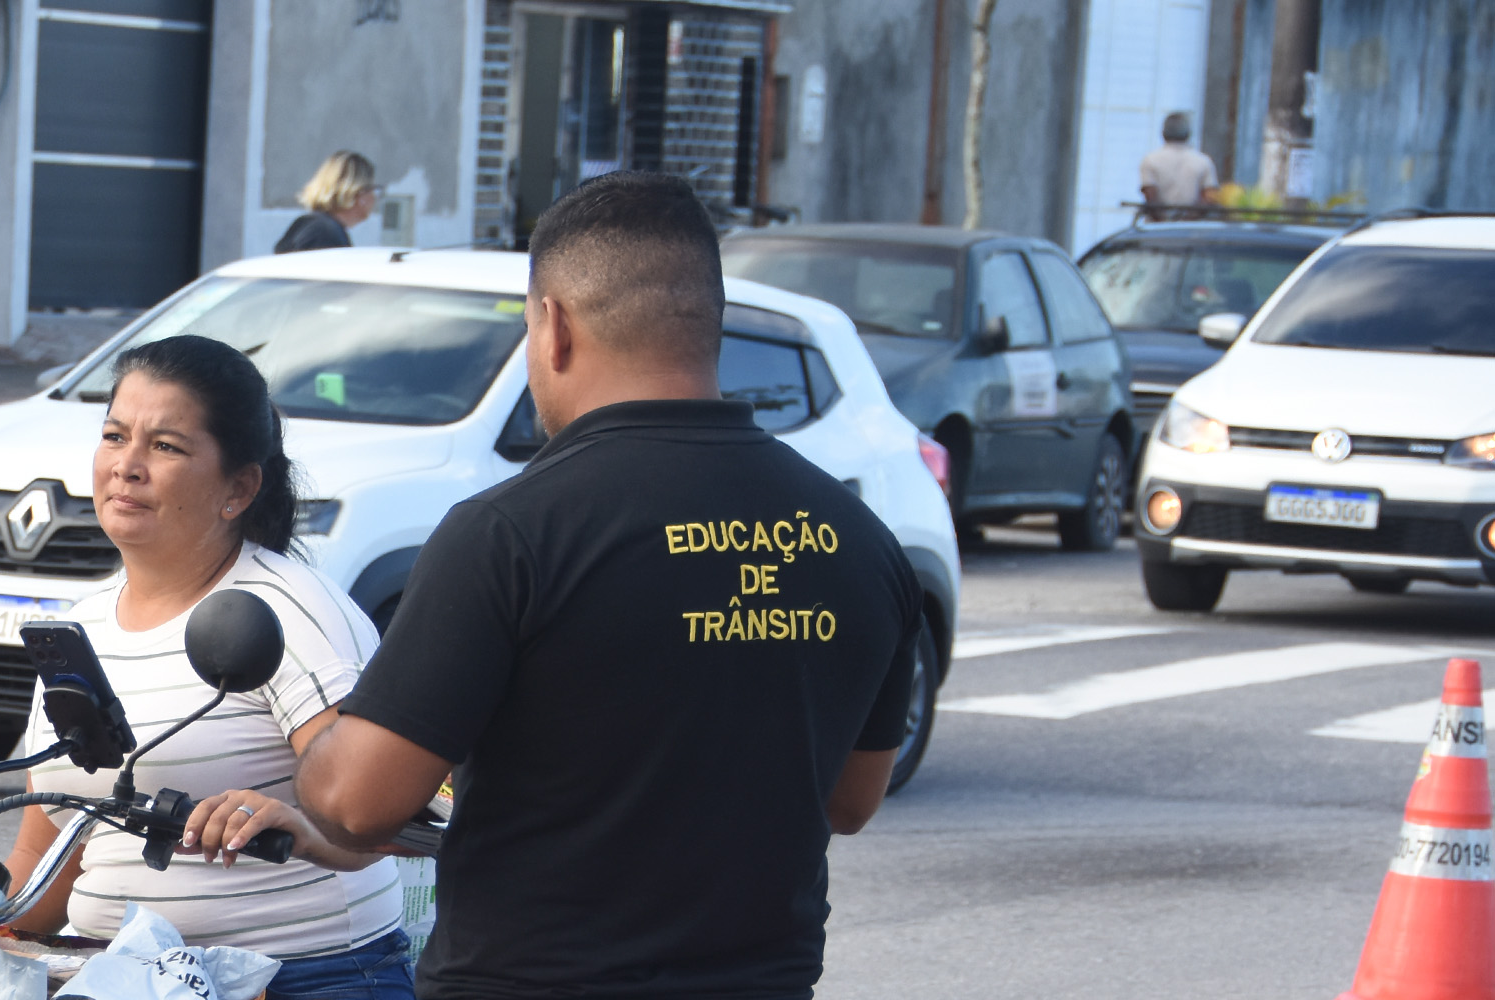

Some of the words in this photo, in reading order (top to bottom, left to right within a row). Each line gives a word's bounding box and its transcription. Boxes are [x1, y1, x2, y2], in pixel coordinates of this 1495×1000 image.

[665, 510, 838, 564] EDUCAÇÃO
[740, 564, 779, 595] DE
[682, 596, 836, 643] TRÂNSITO
